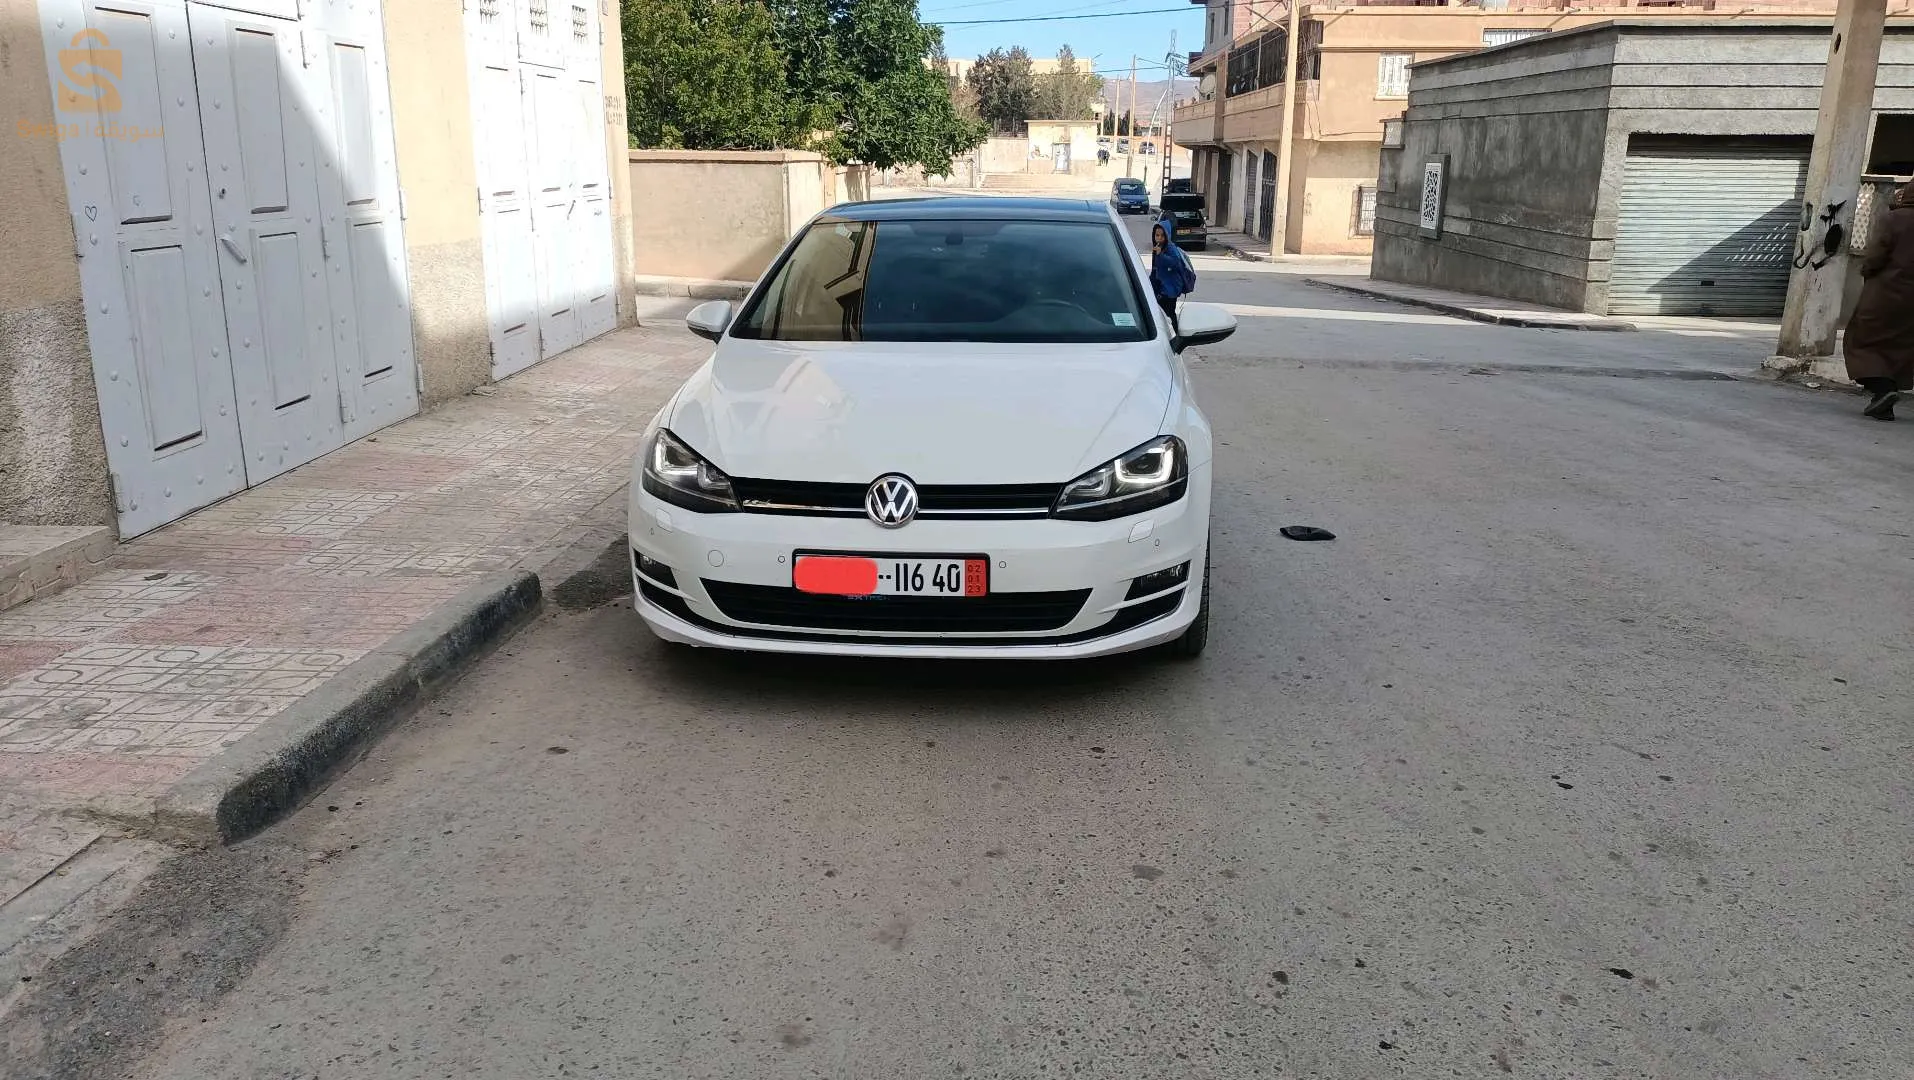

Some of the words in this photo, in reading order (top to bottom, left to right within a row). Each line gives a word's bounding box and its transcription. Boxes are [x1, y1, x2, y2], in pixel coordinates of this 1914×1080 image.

[868, 477, 916, 526] VW
[932, 563, 961, 593] 40
[967, 584, 981, 593] 23
